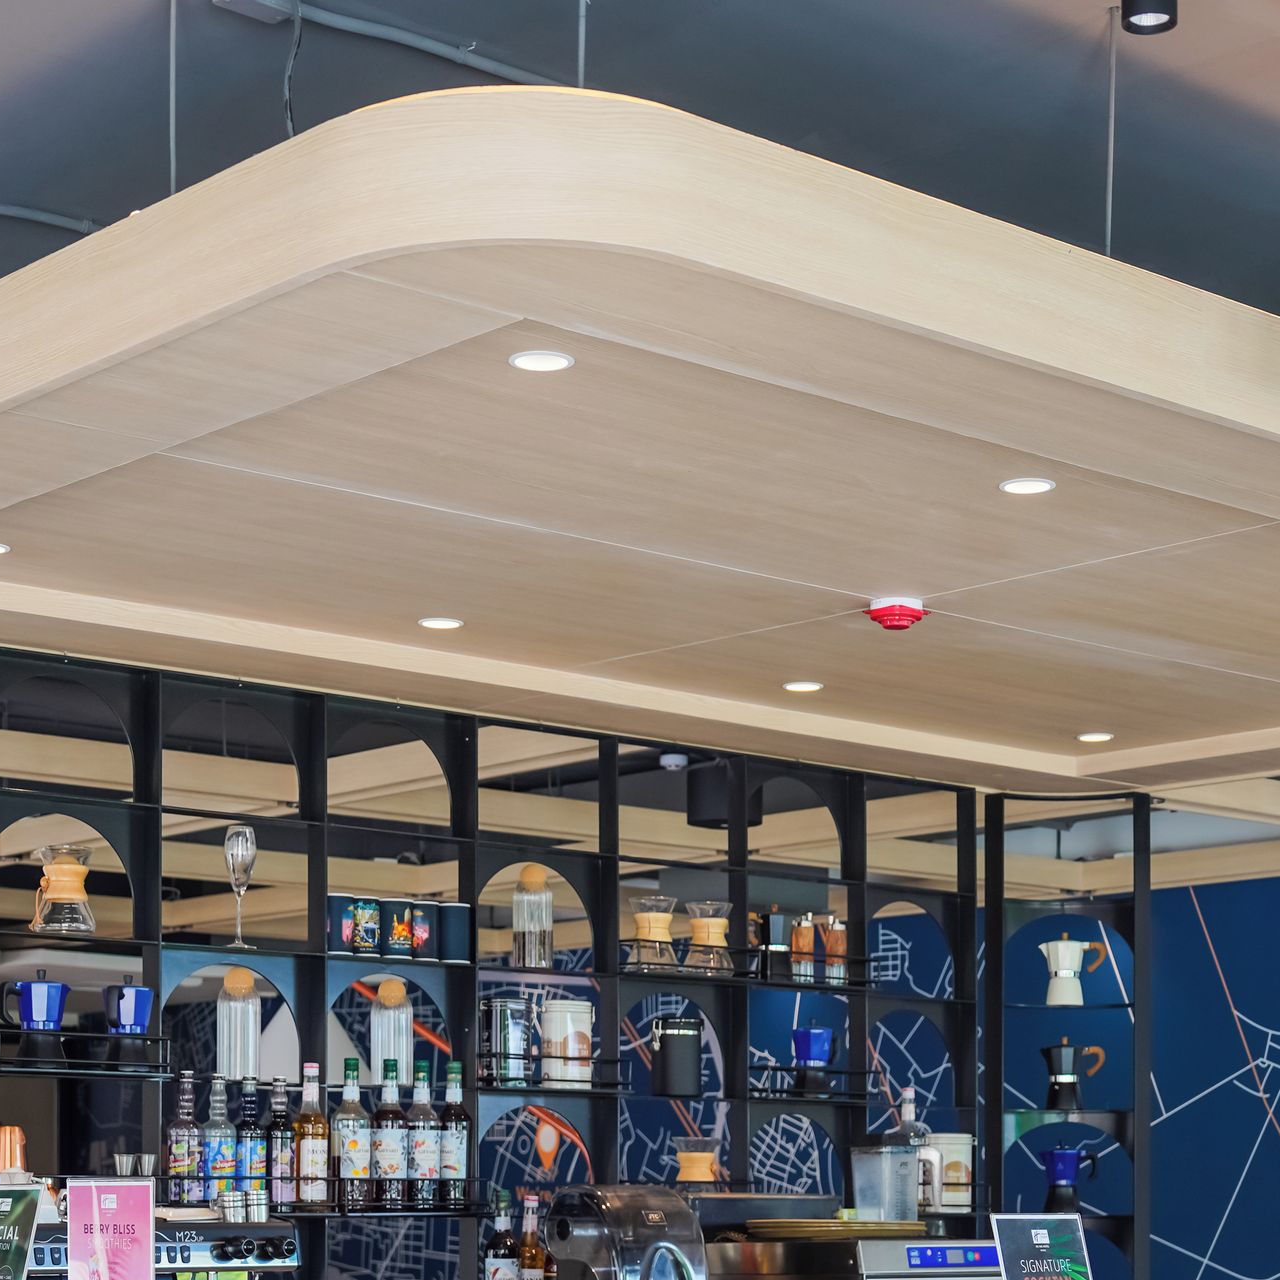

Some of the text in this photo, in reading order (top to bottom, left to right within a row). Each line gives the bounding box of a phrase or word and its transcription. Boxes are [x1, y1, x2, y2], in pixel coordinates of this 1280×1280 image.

[83, 1223, 136, 1235] BERY BLISS
[1019, 1259, 1073, 1273] SIGNATURE
